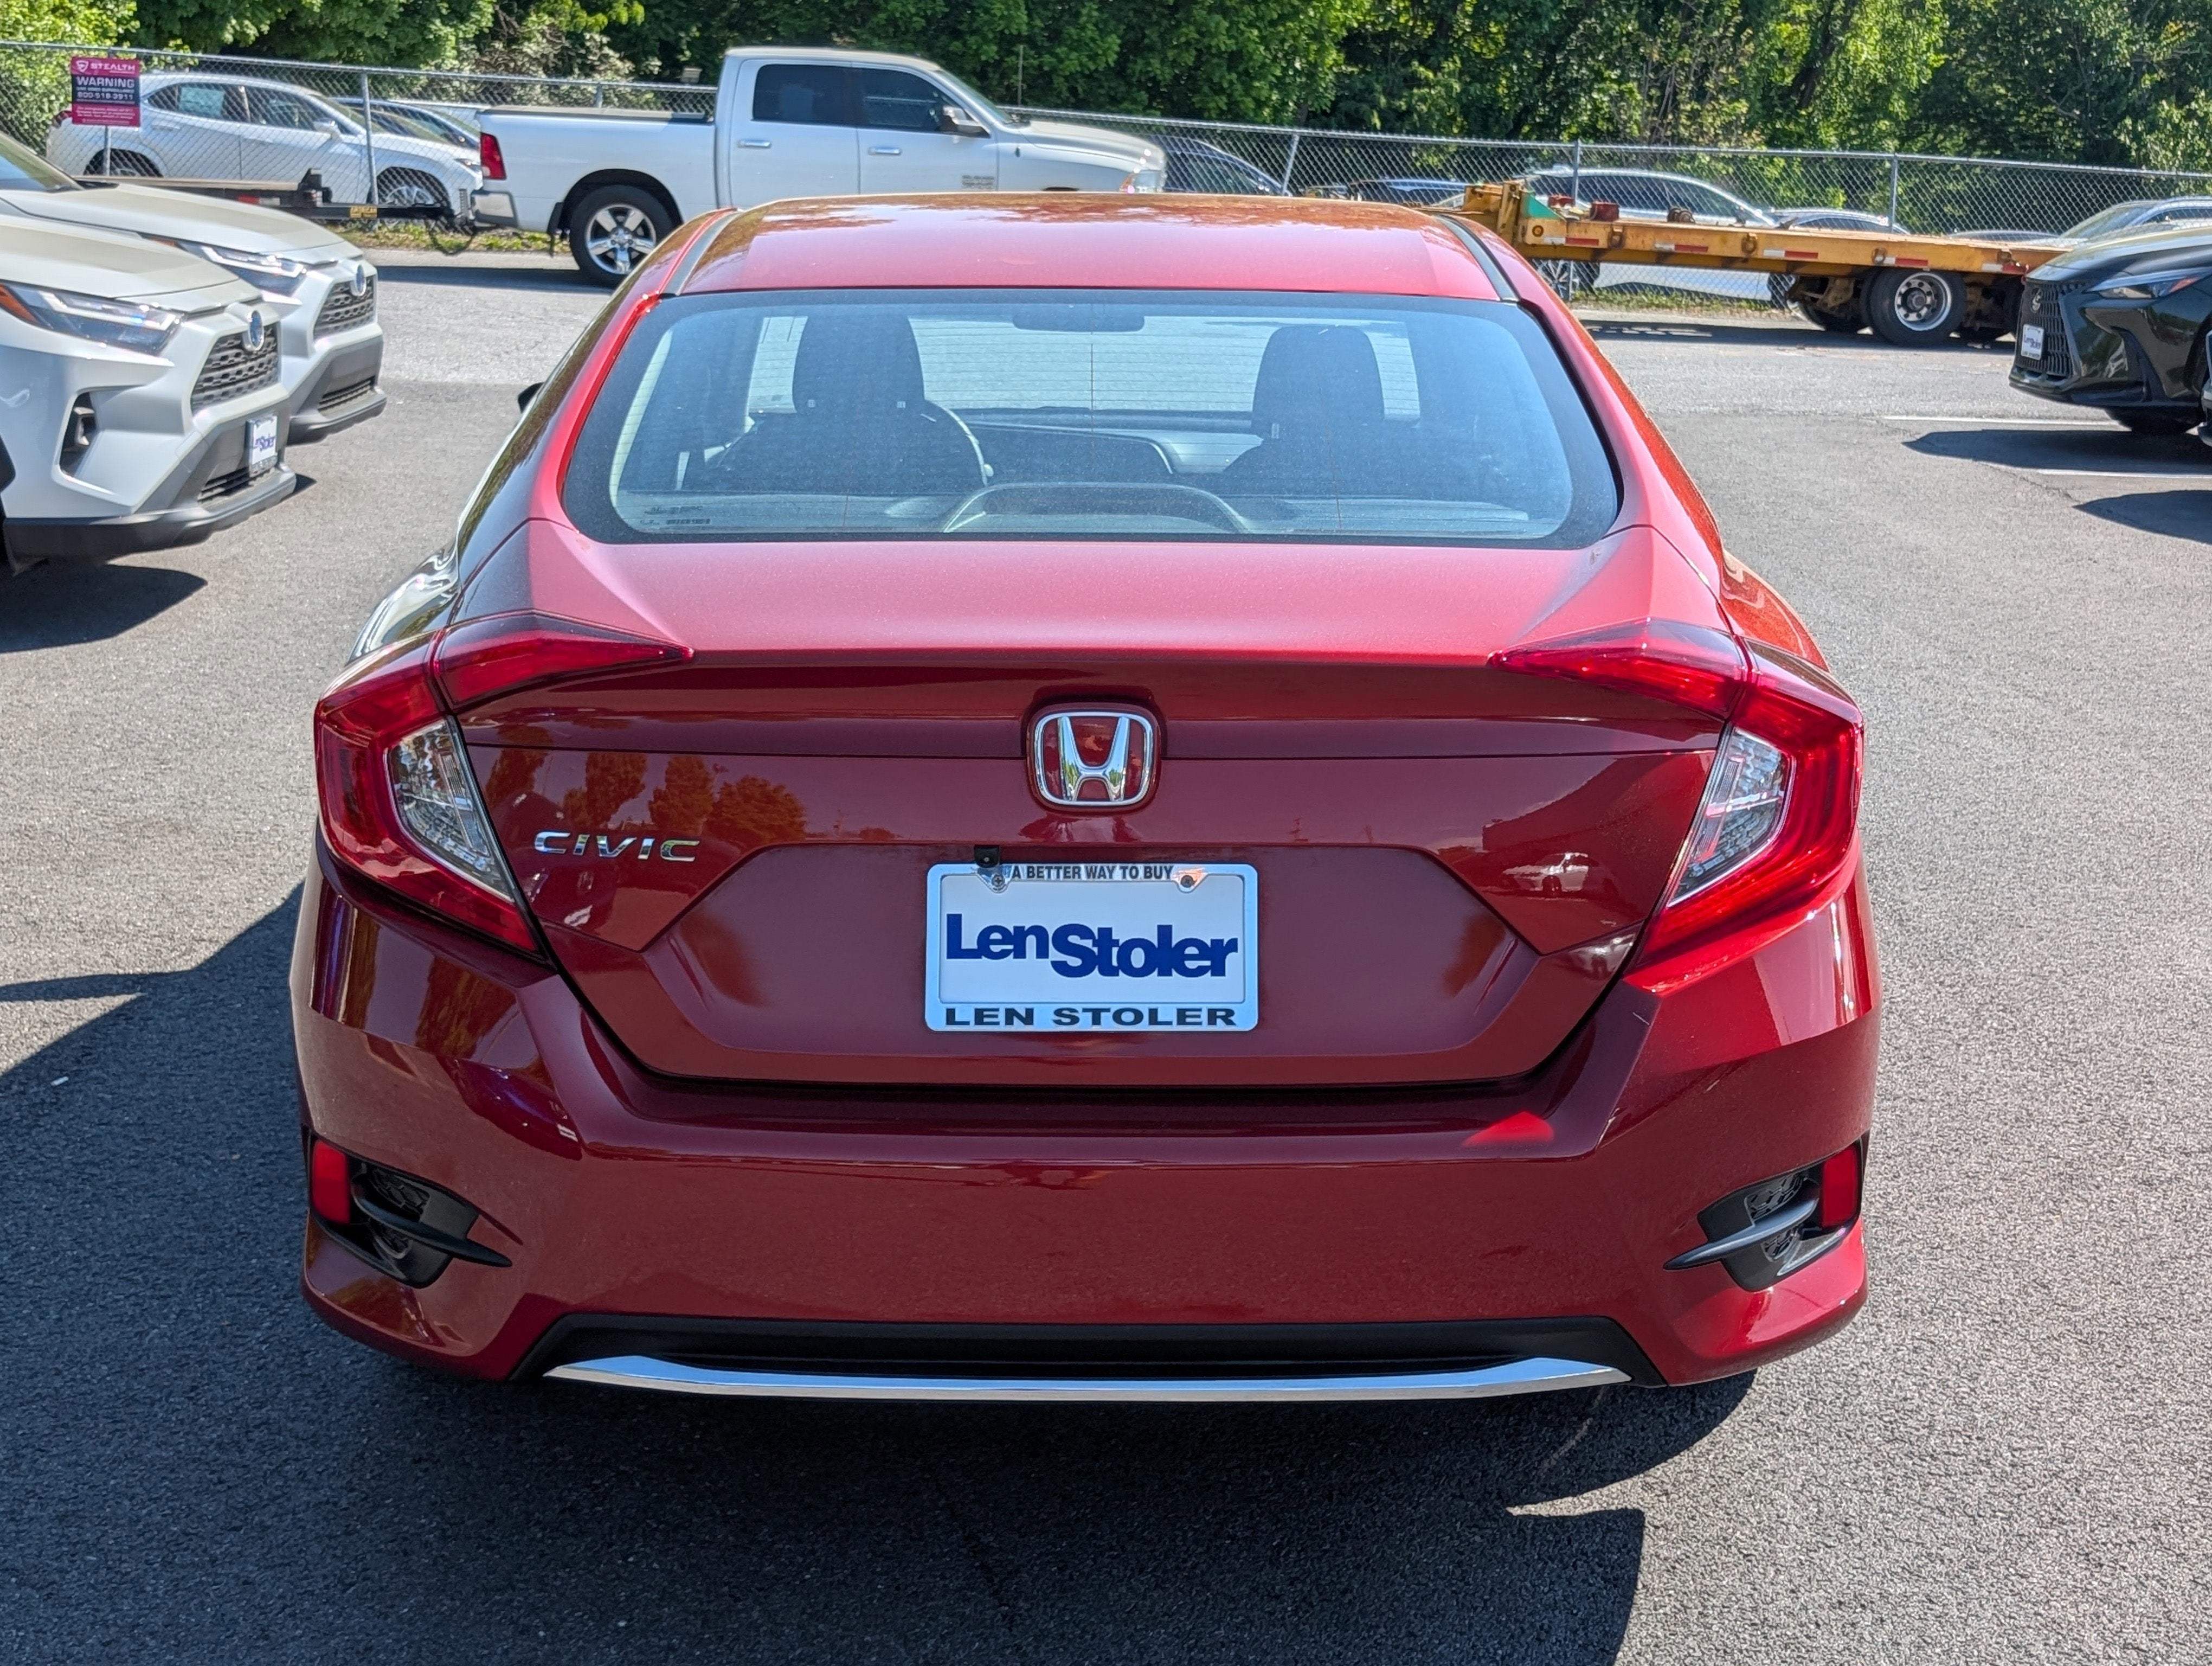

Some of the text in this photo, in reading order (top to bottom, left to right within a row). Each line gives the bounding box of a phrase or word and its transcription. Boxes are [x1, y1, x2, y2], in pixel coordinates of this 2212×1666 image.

[90, 62, 136, 71] STEALTH
[76, 76, 135, 88] WARNING
[533, 831, 700, 862] CIVIC
[1011, 866, 1175, 879] A BETTER WAY TO BUY
[945, 1007, 1237, 1027] LEN STOLER
